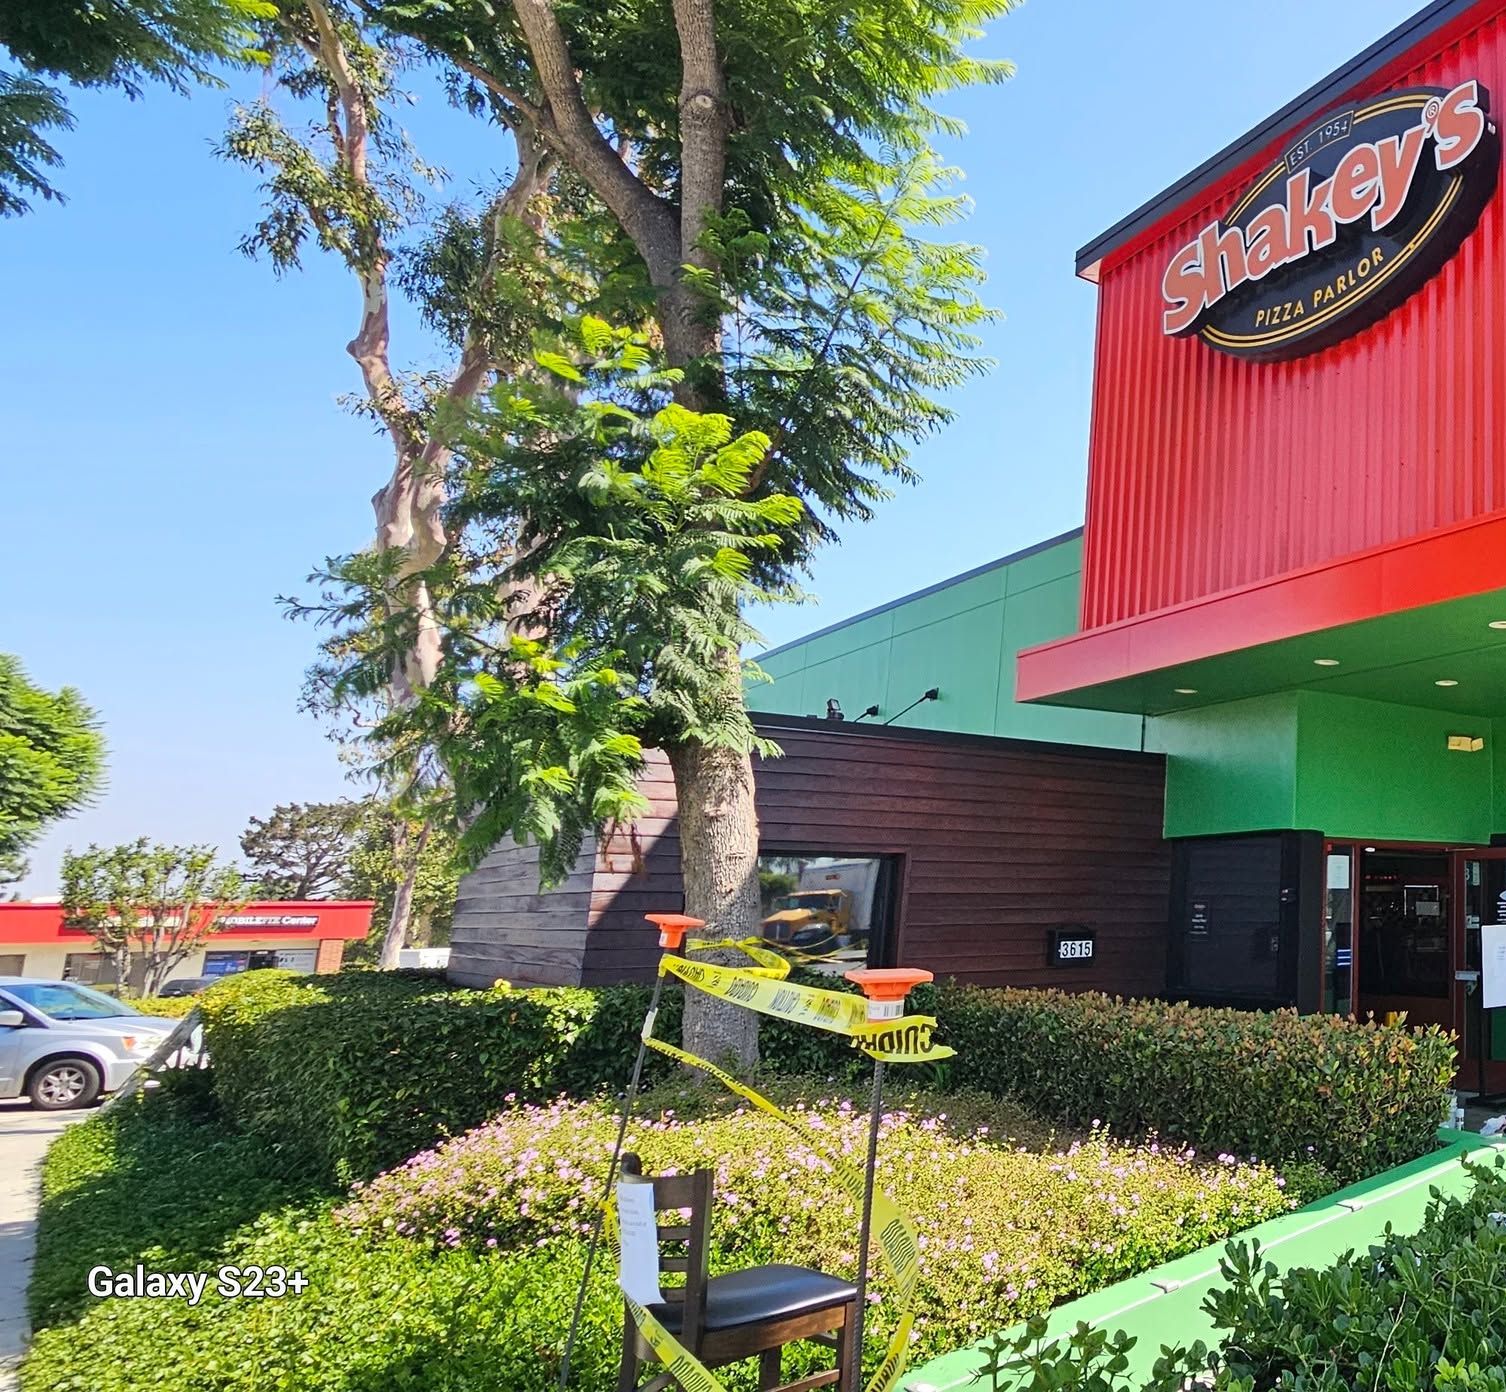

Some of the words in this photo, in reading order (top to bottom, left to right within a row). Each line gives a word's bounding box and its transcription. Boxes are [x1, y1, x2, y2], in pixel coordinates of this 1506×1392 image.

[1319, 119, 1348, 144] 1954
[1163, 80, 1484, 334] Shakey's
[1255, 299, 1305, 328] PIZZA
[1312, 247, 1384, 308] PARLOR
[1062, 942, 1091, 957] 3615
